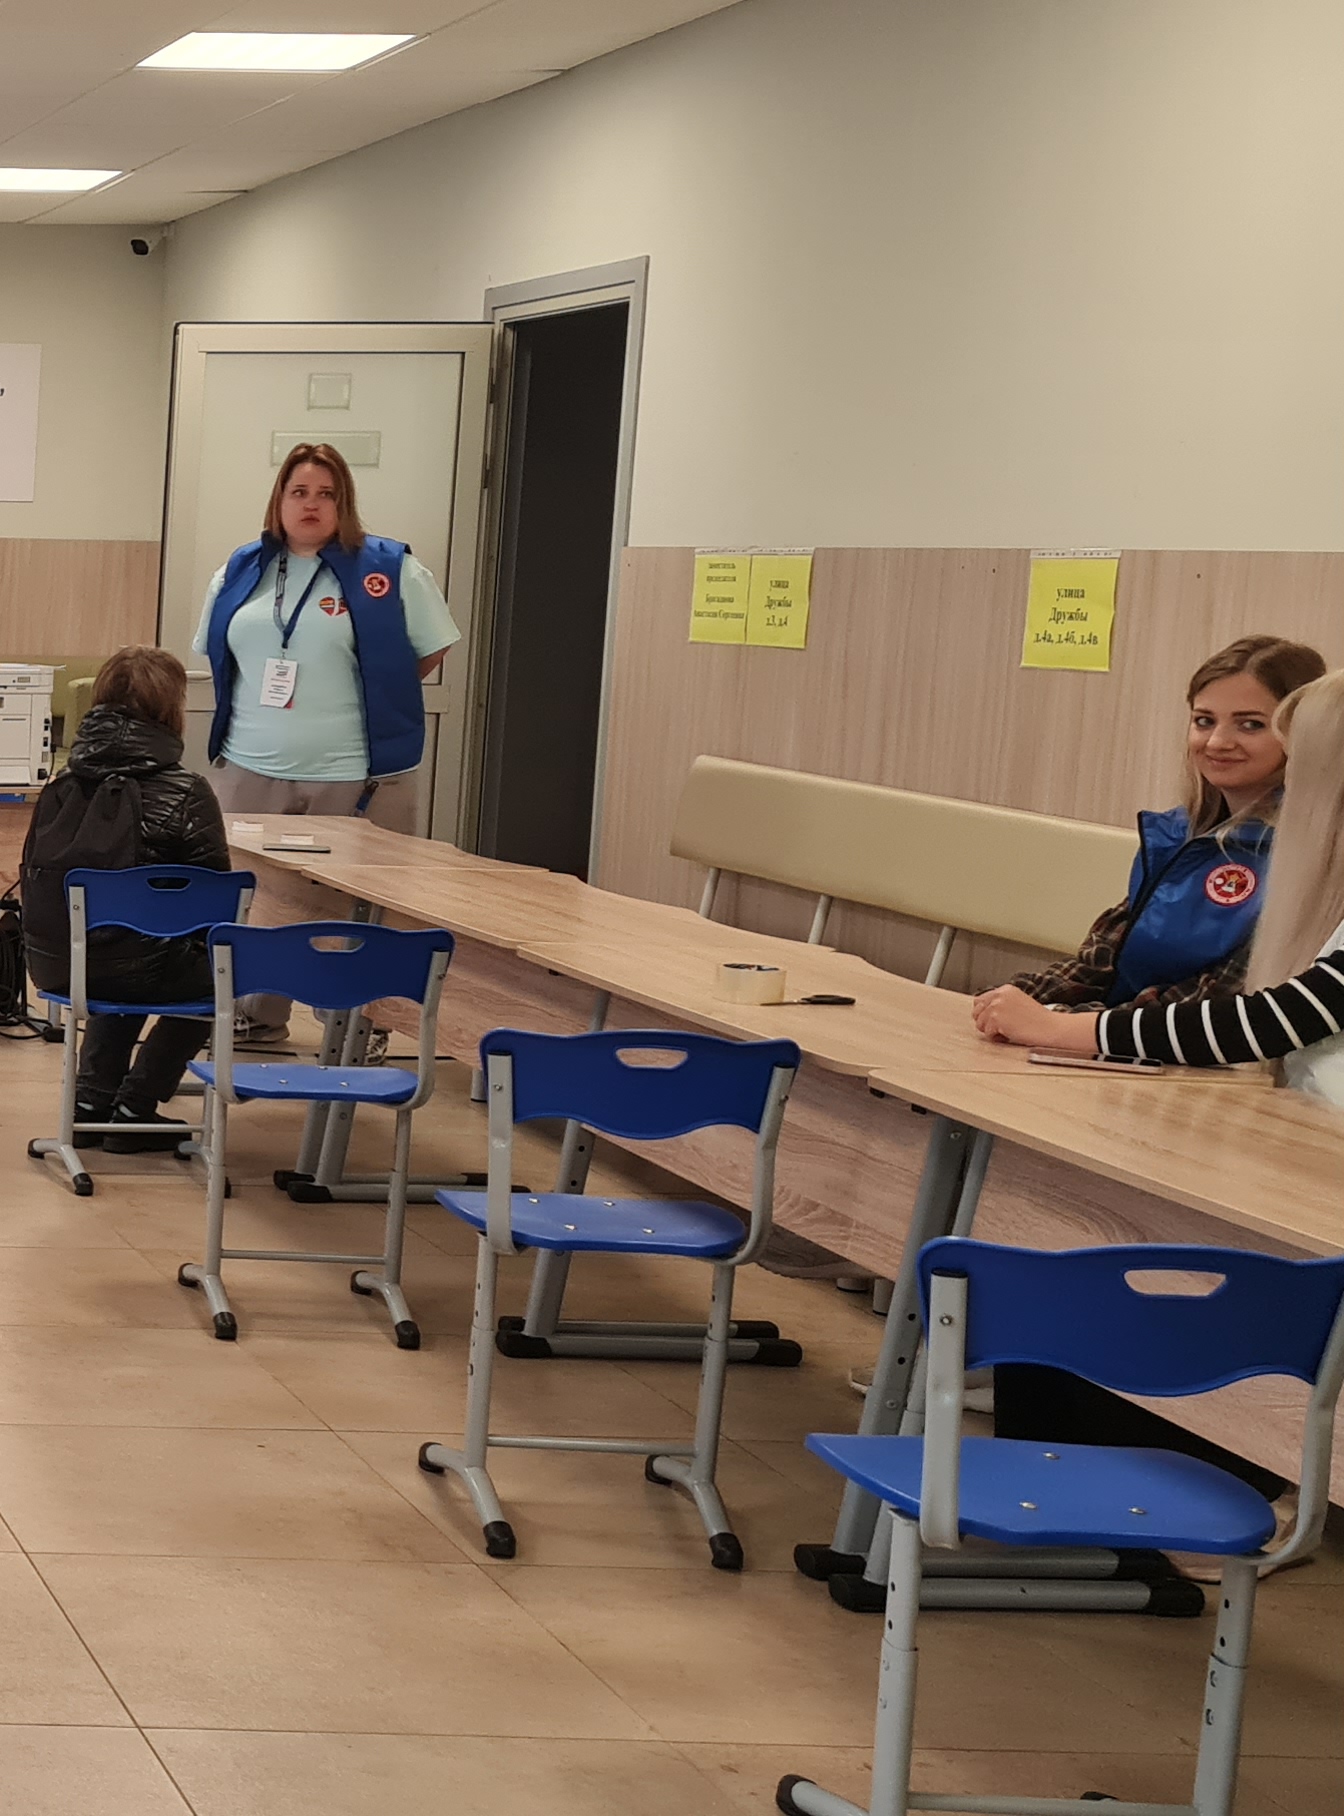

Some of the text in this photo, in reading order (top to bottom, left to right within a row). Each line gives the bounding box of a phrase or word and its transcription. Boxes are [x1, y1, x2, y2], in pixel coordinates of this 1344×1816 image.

[1056, 588, 1085, 601] улица
[764, 595, 792, 610] Дружбы
[1048, 607, 1088, 624] Дружбы
